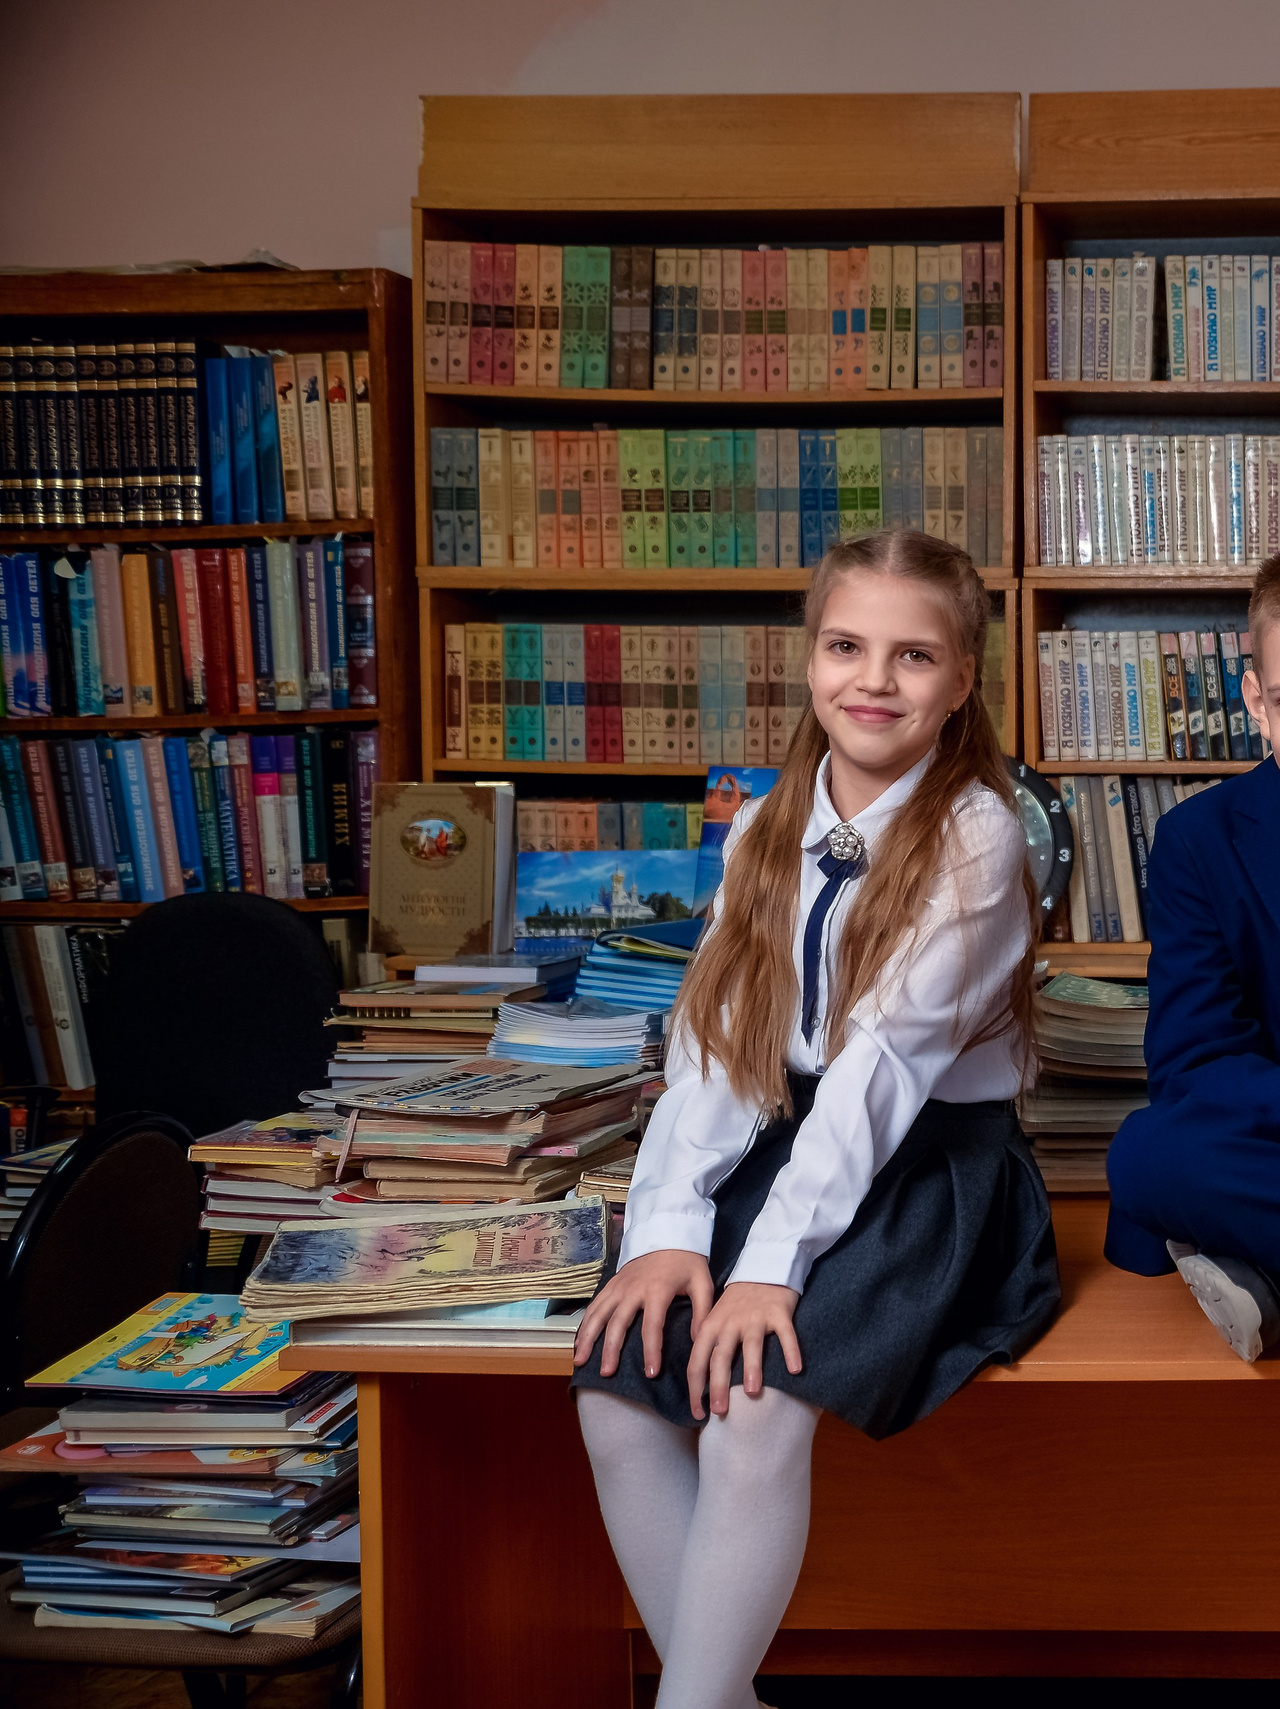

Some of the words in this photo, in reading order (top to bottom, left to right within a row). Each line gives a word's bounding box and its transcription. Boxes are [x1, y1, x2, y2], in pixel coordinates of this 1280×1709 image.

[1206, 285, 1217, 310] МИР
[1206, 312, 1218, 360] ПОЗНАЮ
[1207, 363, 1218, 372] Я
[1059, 660, 1070, 685] МИР
[1077, 663, 1088, 687] МИР
[1109, 664, 1121, 687] МИР
[1125, 662, 1136, 686] МИР
[1207, 677, 1217, 698] ВСЕ
[1060, 688, 1072, 737] ПОЗНАЮ
[1078, 690, 1090, 736] ПОЗНАЮ
[1111, 690, 1124, 737] ПОЗНАЮ
[1127, 689, 1140, 736] ПОЗНАЮ
[1062, 739, 1073, 748] Я
[1080, 739, 1091, 748] Я
[1114, 739, 1125, 748] Я
[1129, 738, 1140, 747] Я
[125, 750, 138, 781] ДЕТЕЙ
[1019, 765, 1025, 777] 1
[131, 785, 141, 805] ДЛЯ
[1049, 799, 1060, 813] 2
[1128, 785, 1139, 815] такой
[1142, 787, 1153, 817] такой
[332, 782, 349, 846] ХИМИЯ
[1132, 815, 1142, 834] Кто
[136, 810, 154, 891] ЭНЦИКЛОПЕДИЯ
[220, 800, 238, 881] МАТЕМАТИКА
[1138, 837, 1147, 867] такое
[1059, 849, 1070, 862] 3
[1041, 897, 1053, 910] 4
[1092, 920, 1102, 940] Том
[1109, 920, 1119, 940] Том
[70, 935, 88, 1003] ИНФОРМАТИКА
